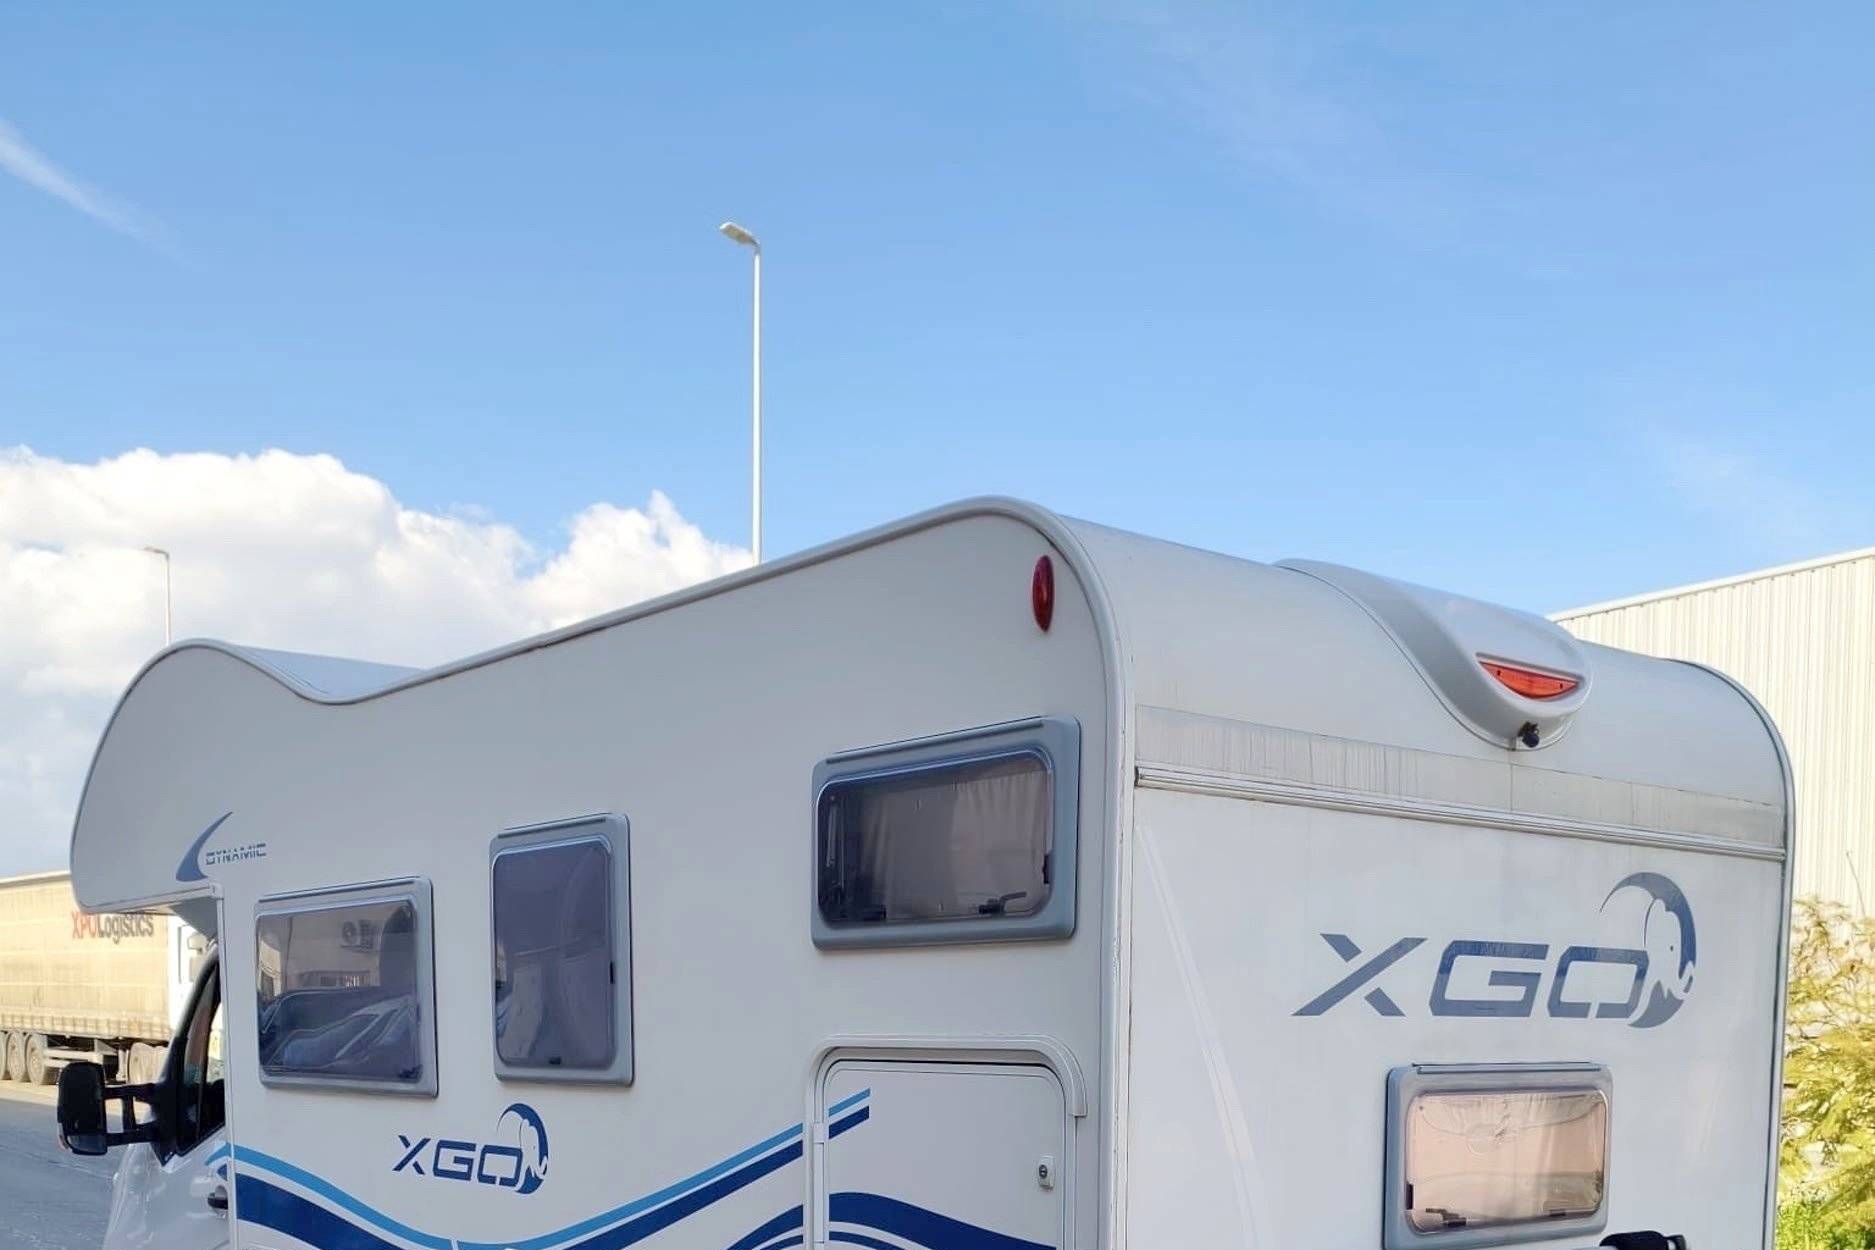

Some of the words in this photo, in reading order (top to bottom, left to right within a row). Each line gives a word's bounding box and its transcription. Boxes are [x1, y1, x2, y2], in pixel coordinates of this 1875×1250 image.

[206, 843, 267, 866] DYNAMIC
[1291, 933, 1649, 1018] XGO
[392, 1135, 523, 1188] XGO
